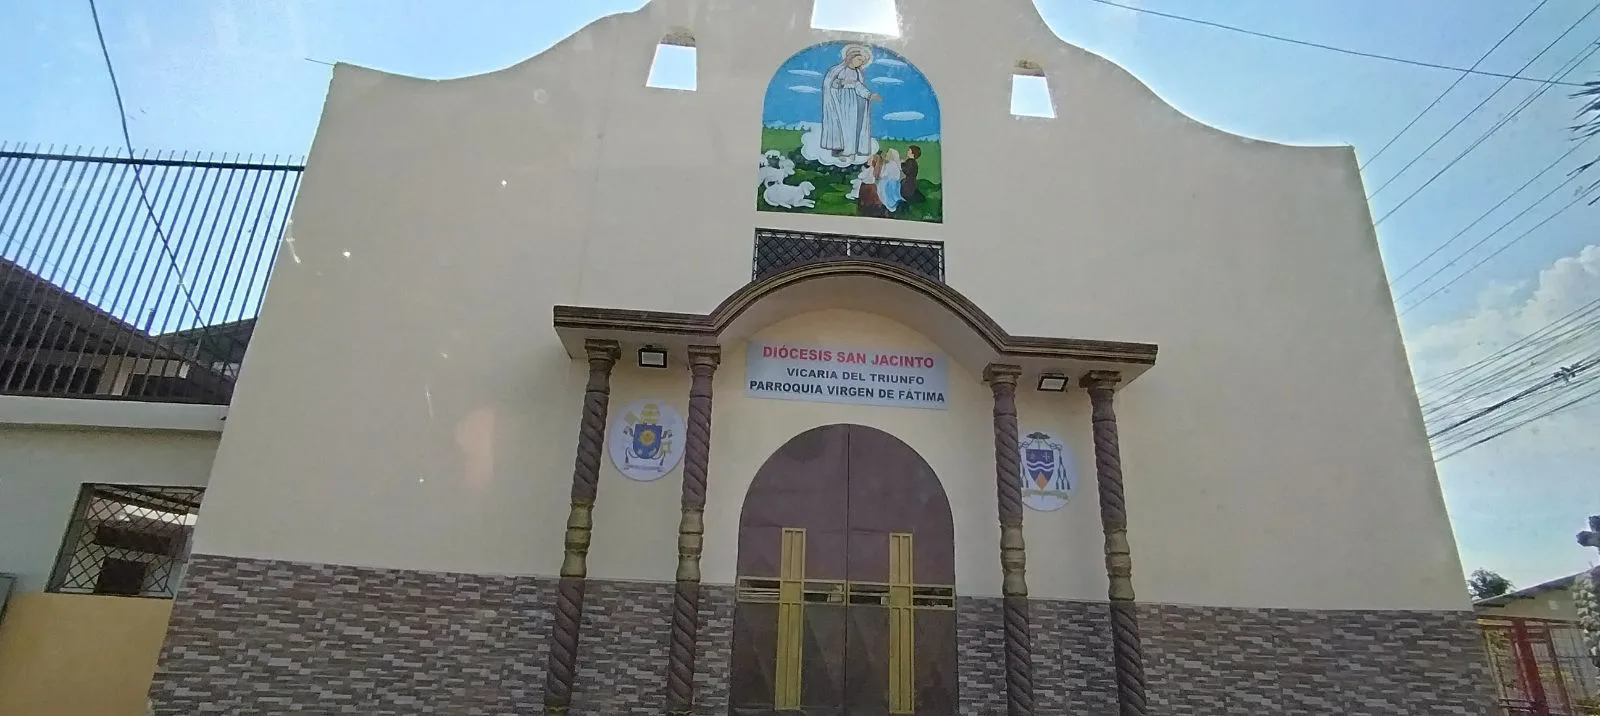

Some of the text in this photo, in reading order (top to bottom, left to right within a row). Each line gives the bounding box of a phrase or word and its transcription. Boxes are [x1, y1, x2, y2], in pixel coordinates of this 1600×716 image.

[763, 345, 934, 368] DIÓCESIS SAN JACINTO
[786, 368, 924, 385] VICARIA DEL TRIUNFO
[750, 380, 945, 402] PARROQUIA VIRGEN DE FÁTIMA
